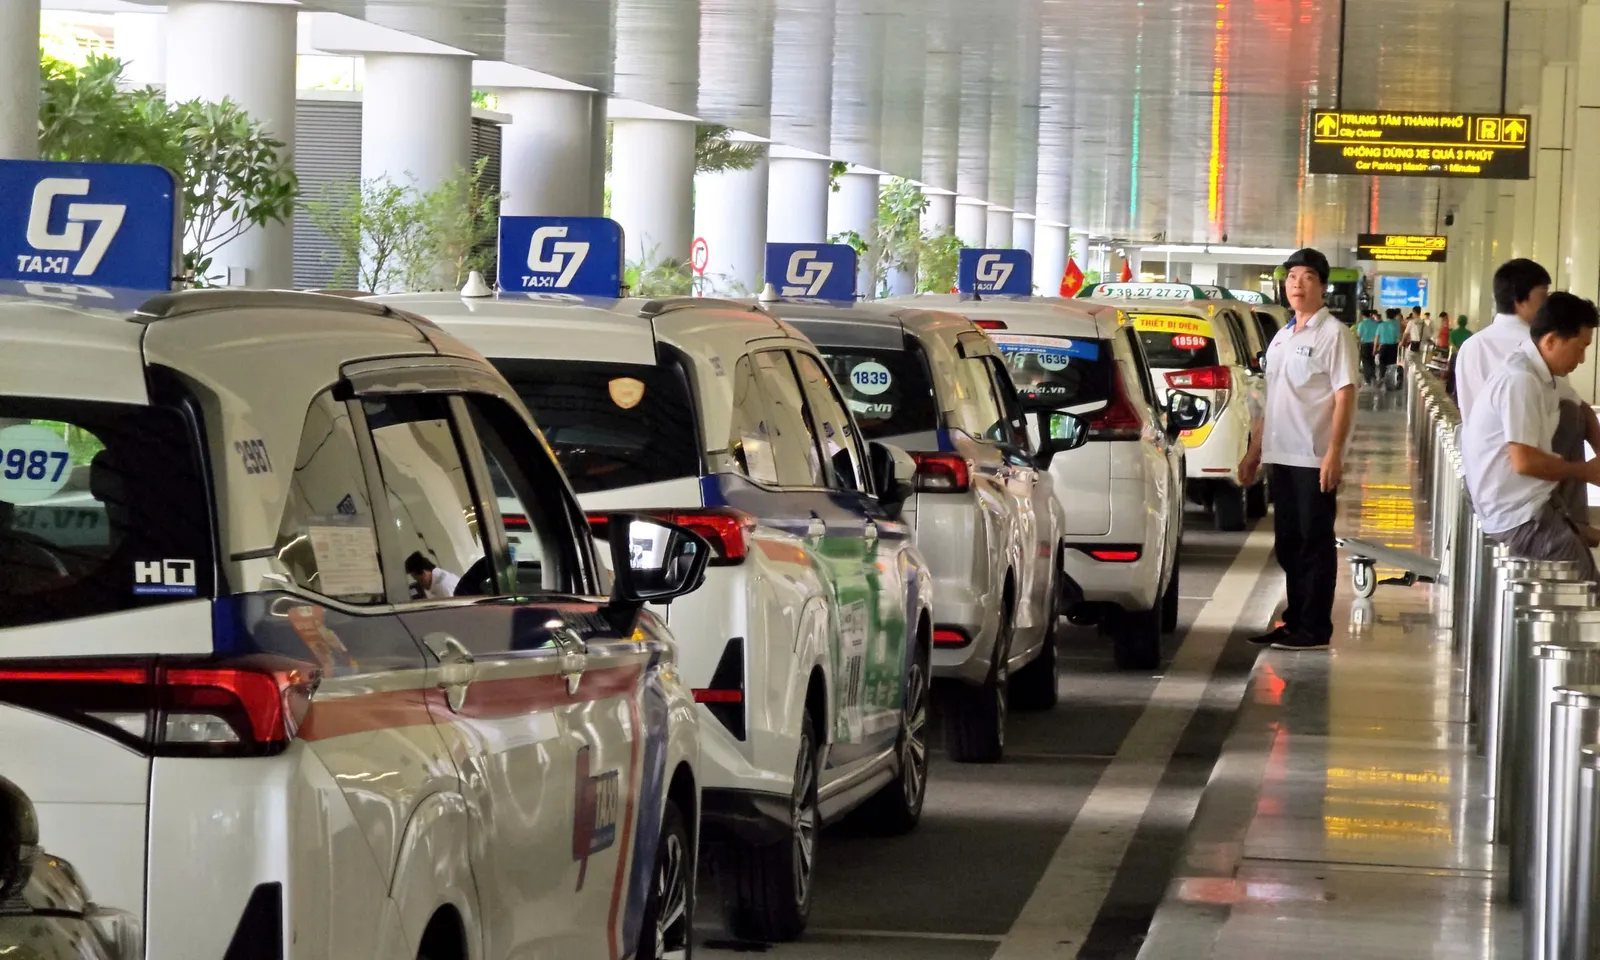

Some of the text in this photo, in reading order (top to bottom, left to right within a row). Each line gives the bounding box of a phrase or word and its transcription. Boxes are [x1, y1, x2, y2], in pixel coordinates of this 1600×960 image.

[1341, 114, 1377, 125] TRUNG
[1340, 128, 1355, 138] City
[1342, 145, 1381, 157] KHÔNG
[1415, 149, 1430, 159] XE
[1465, 149, 1494, 162] PHÚT
[1356, 161, 1371, 170] Car
[1372, 162, 1401, 172] Parking
[1449, 163, 1480, 173] Minutes
[26, 177, 127, 276] G7
[527, 226, 590, 288] G7
[17, 255, 70, 274] TAXI
[786, 250, 834, 296] G7
[976, 253, 1014, 291] G7
[521, 275, 555, 288] TAXI
[972, 283, 993, 291] TAXI
[1155, 288, 1171, 298] 27
[1174, 288, 1190, 299] 27
[1204, 289, 1218, 299] 27
[1039, 354, 1067, 365] 1636
[853, 371, 888, 385] 1839
[0, 448, 69, 482] 987
[134, 559, 194, 585] HT
